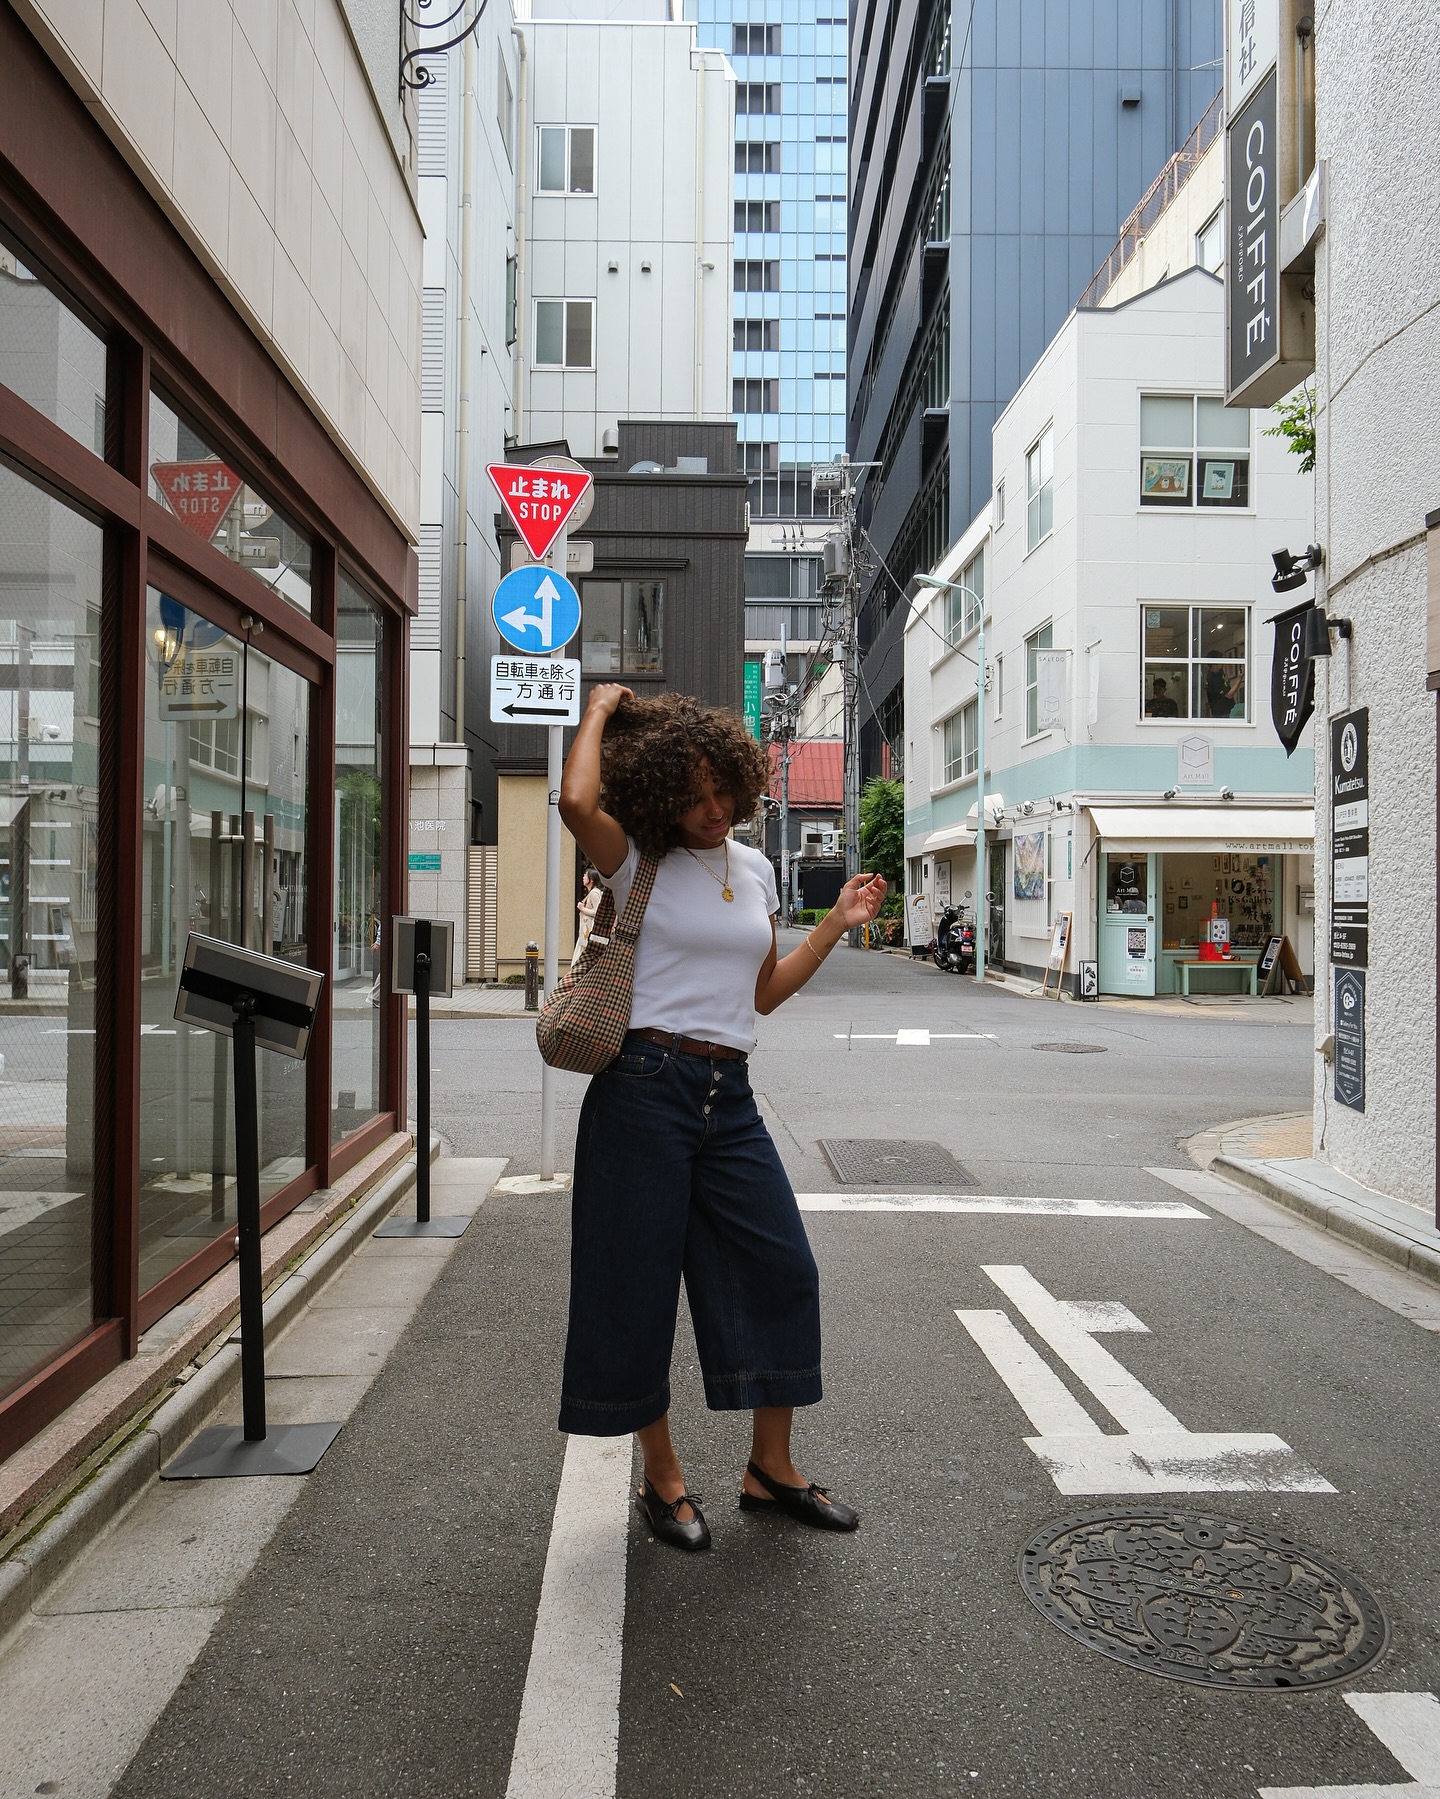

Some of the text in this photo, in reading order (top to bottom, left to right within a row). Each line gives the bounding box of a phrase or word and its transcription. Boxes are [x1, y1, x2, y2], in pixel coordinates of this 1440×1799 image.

[1238, 0, 1257, 86] 信社
[1246, 120, 1270, 358] COIFFÉ
[508, 476, 571, 500] 止まれ
[519, 502, 562, 521] STOP
[496, 661, 575, 682] 自転車を除く
[1284, 622, 1301, 726] COIFFÉ
[496, 682, 575, 701] 一方通行
[1241, 896, 1273, 905] Gallery
